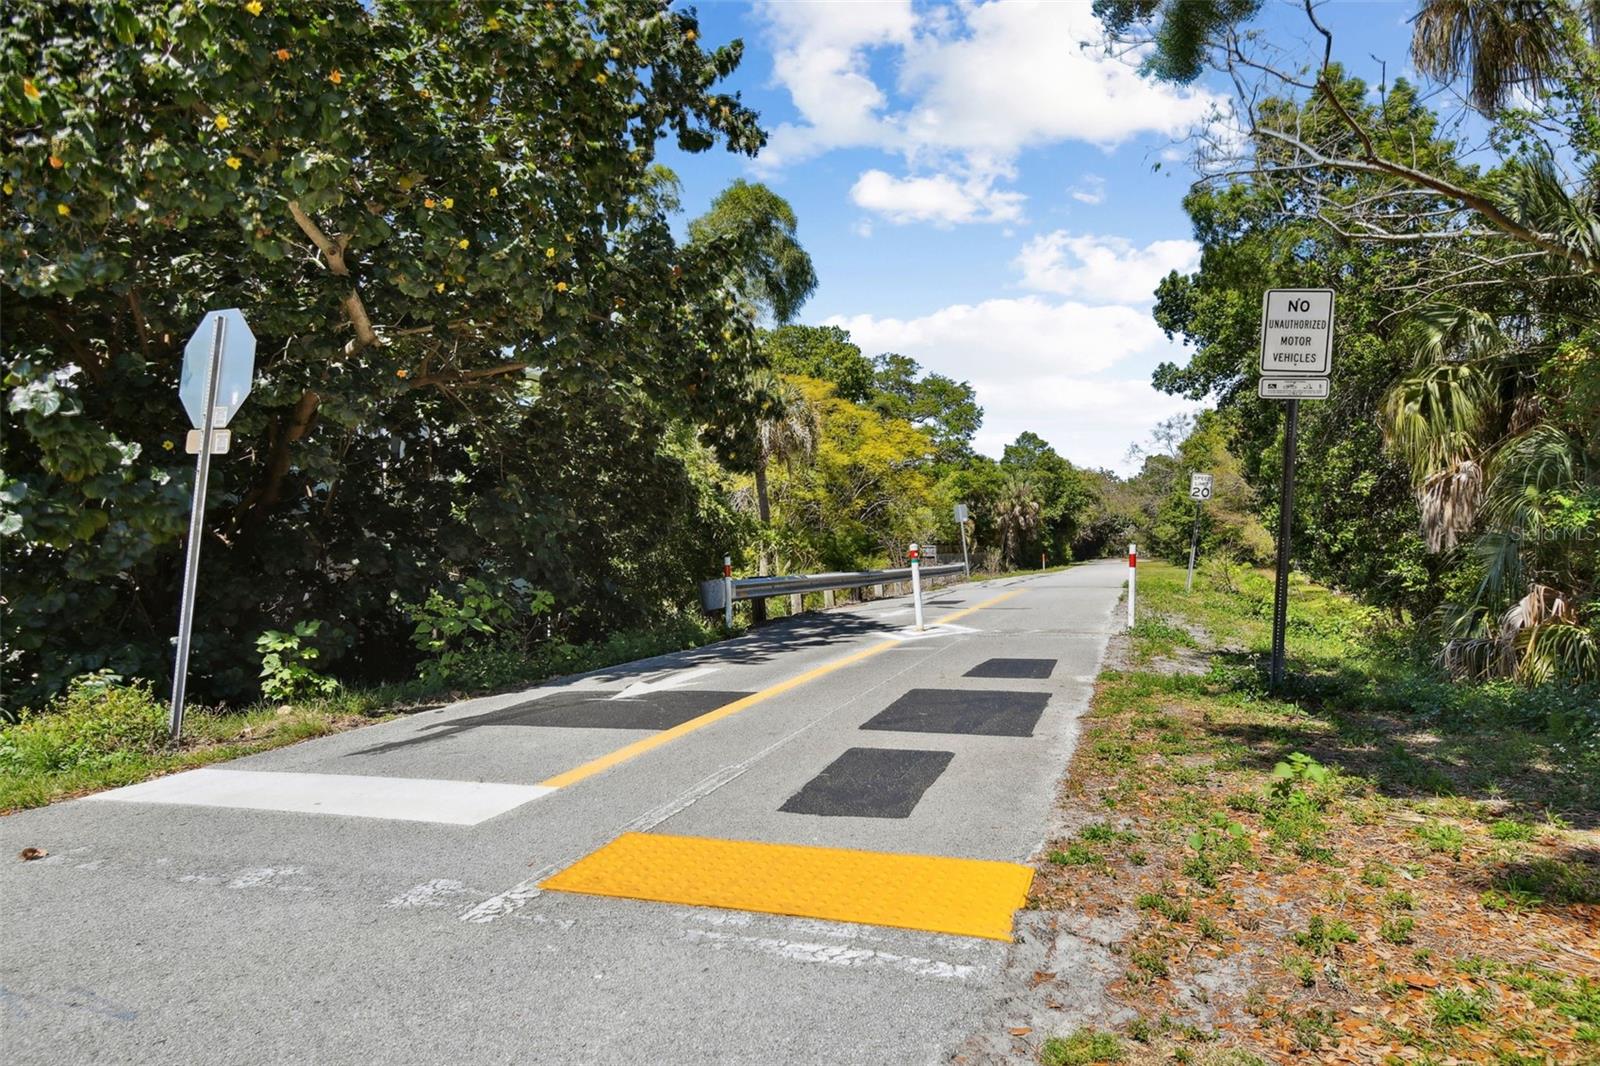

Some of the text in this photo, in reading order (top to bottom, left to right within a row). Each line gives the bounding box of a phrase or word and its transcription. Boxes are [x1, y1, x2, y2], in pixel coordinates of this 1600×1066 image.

[1288, 300, 1310, 312] NO
[1269, 319, 1327, 330] UNAUTHORIZED
[1280, 336, 1312, 346] MOTOR
[1272, 353, 1317, 363] VEHICLES
[1192, 487, 1210, 497] 20
